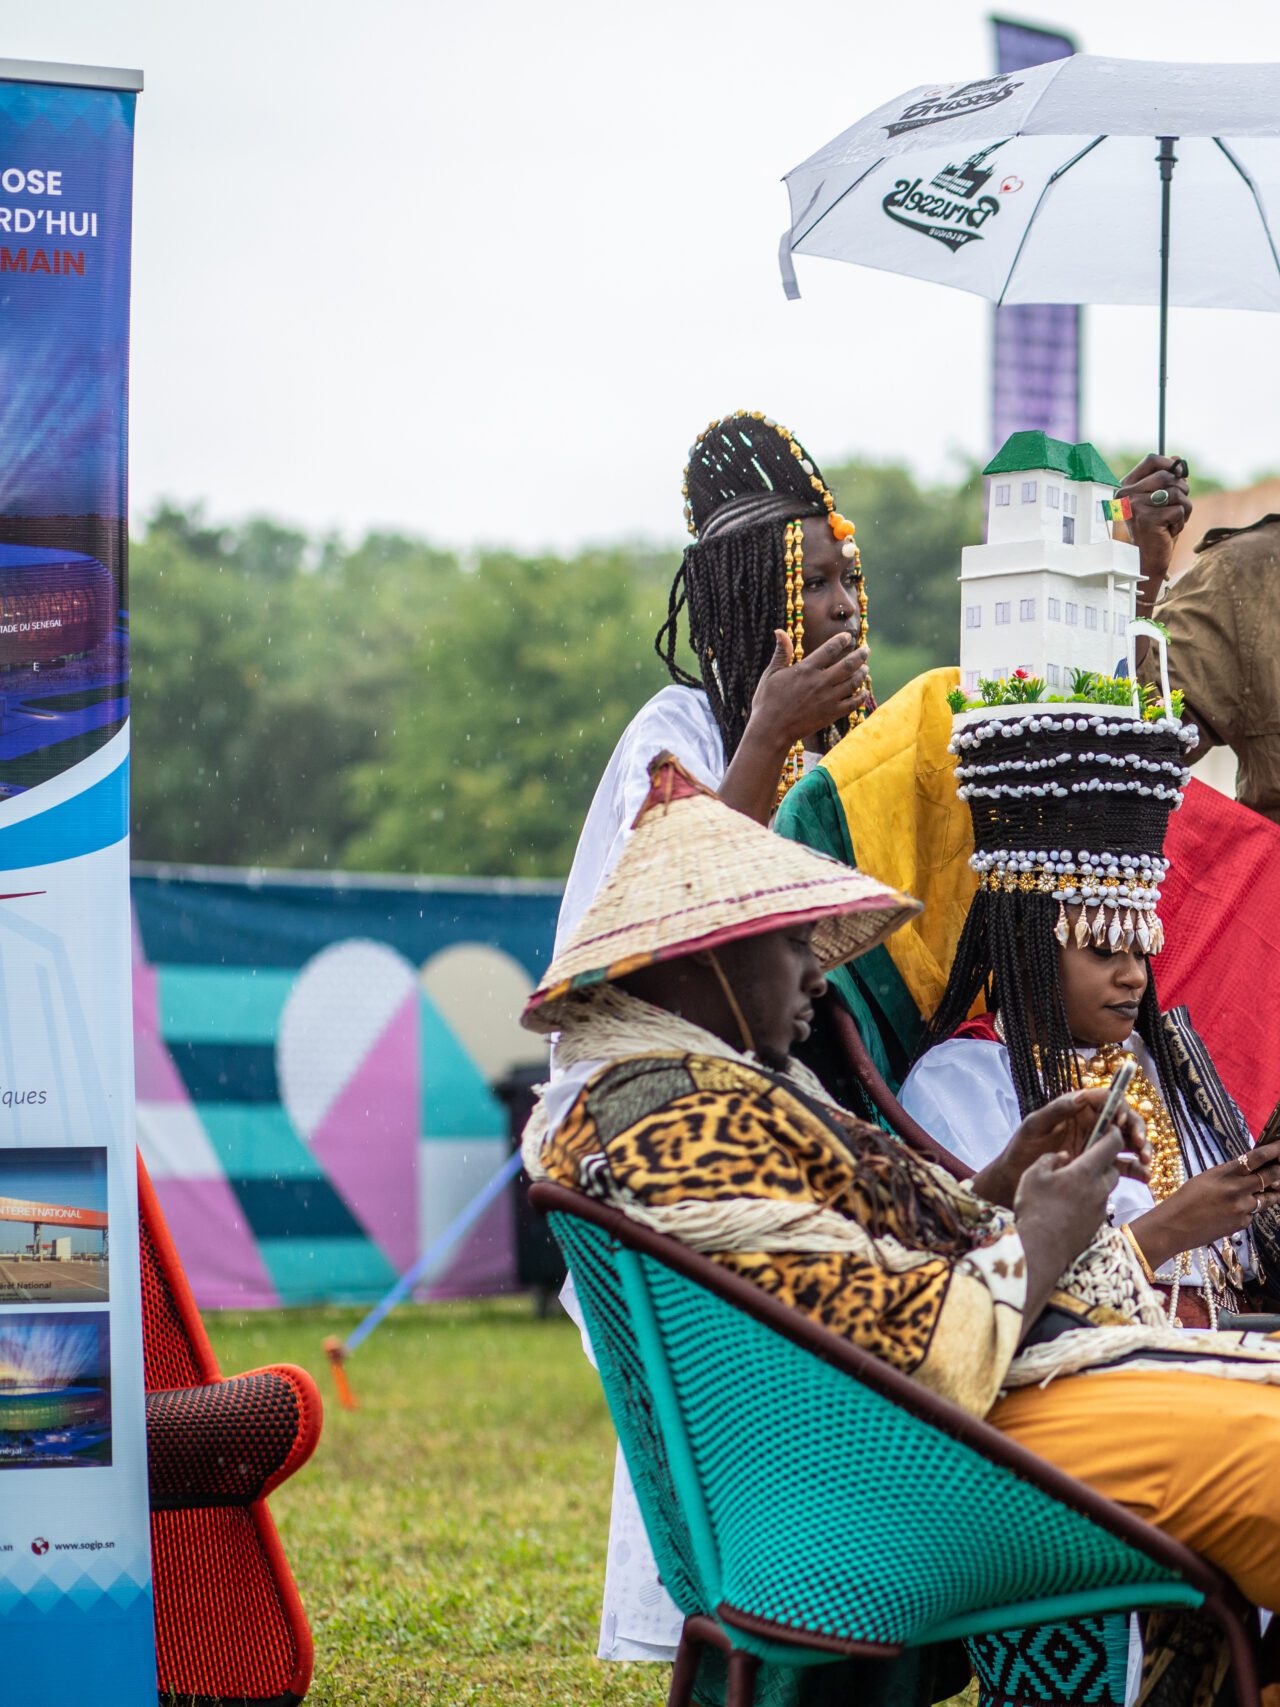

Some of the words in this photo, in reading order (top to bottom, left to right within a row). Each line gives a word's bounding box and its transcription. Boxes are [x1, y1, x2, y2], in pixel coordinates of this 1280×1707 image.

[0, 168, 62, 195] OSE
[0, 1086, 47, 1108] ques
[55, 1541, 115, 1551] www.sogip.sn
